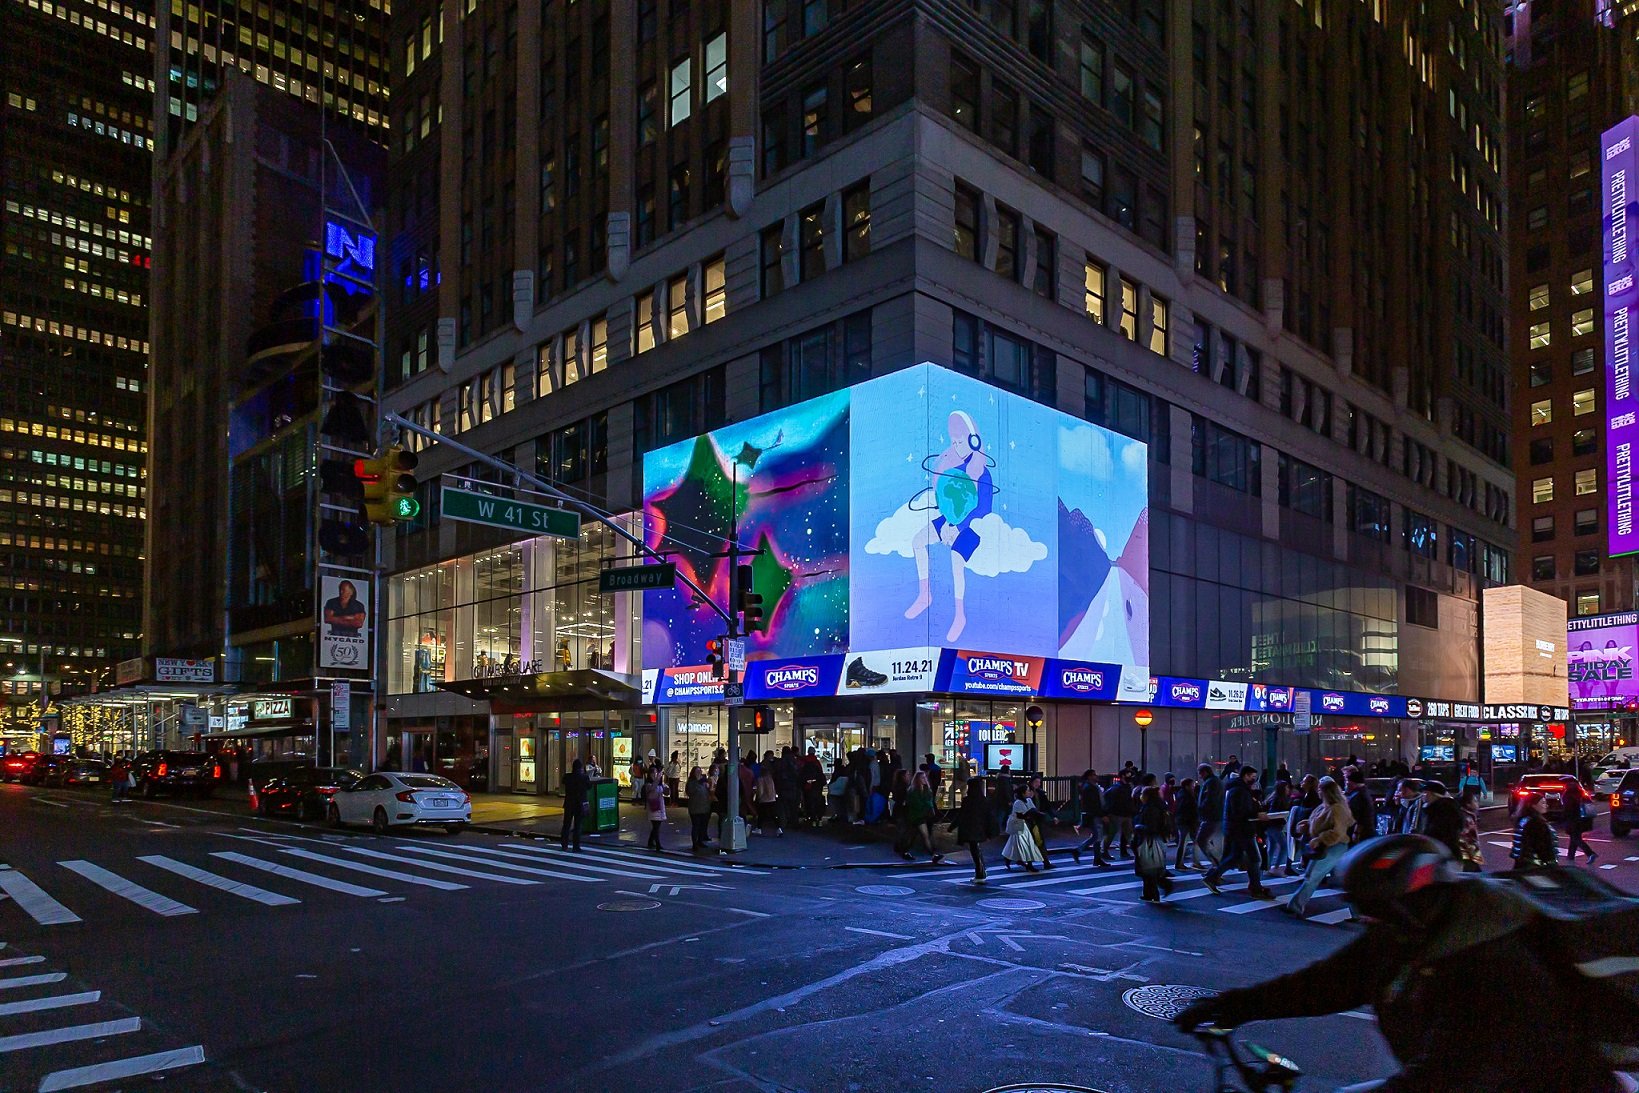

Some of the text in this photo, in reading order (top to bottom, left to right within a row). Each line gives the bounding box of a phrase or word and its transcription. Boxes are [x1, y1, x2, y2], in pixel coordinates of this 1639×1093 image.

[1611, 169, 1627, 264] PRETTYLITTLETHING
[1614, 306, 1630, 401] PRETTYLITTLETHING
[1616, 442, 1632, 536] PRETTYLITTLETHING
[478, 500, 549, 529] W 41 St
[609, 573, 662, 586] Broadway
[336, 647, 351, 658] 50
[1567, 646, 1632, 664] PINK
[158, 667, 212, 677] GIFTS
[891, 660, 933, 674] 11.24.21
[968, 658, 1029, 677] CHAMPS TV
[1568, 659, 1632, 672] FRIDAY
[674, 673, 695, 685] SHOP
[767, 669, 817, 686] CHAMPS
[1063, 671, 1102, 687] CHAMPS
[1568, 667, 1632, 682] SALE
[965, 681, 1032, 692] youtube.com/champssports
[1172, 686, 1199, 698] CHAMPS
[1270, 692, 1288, 704] CHAMPS
[1323, 696, 1344, 707] CHAMPS
[265, 700, 290, 715] PIZZA
[1370, 700, 1389, 710] CHAMPS
[677, 722, 713, 733] women
